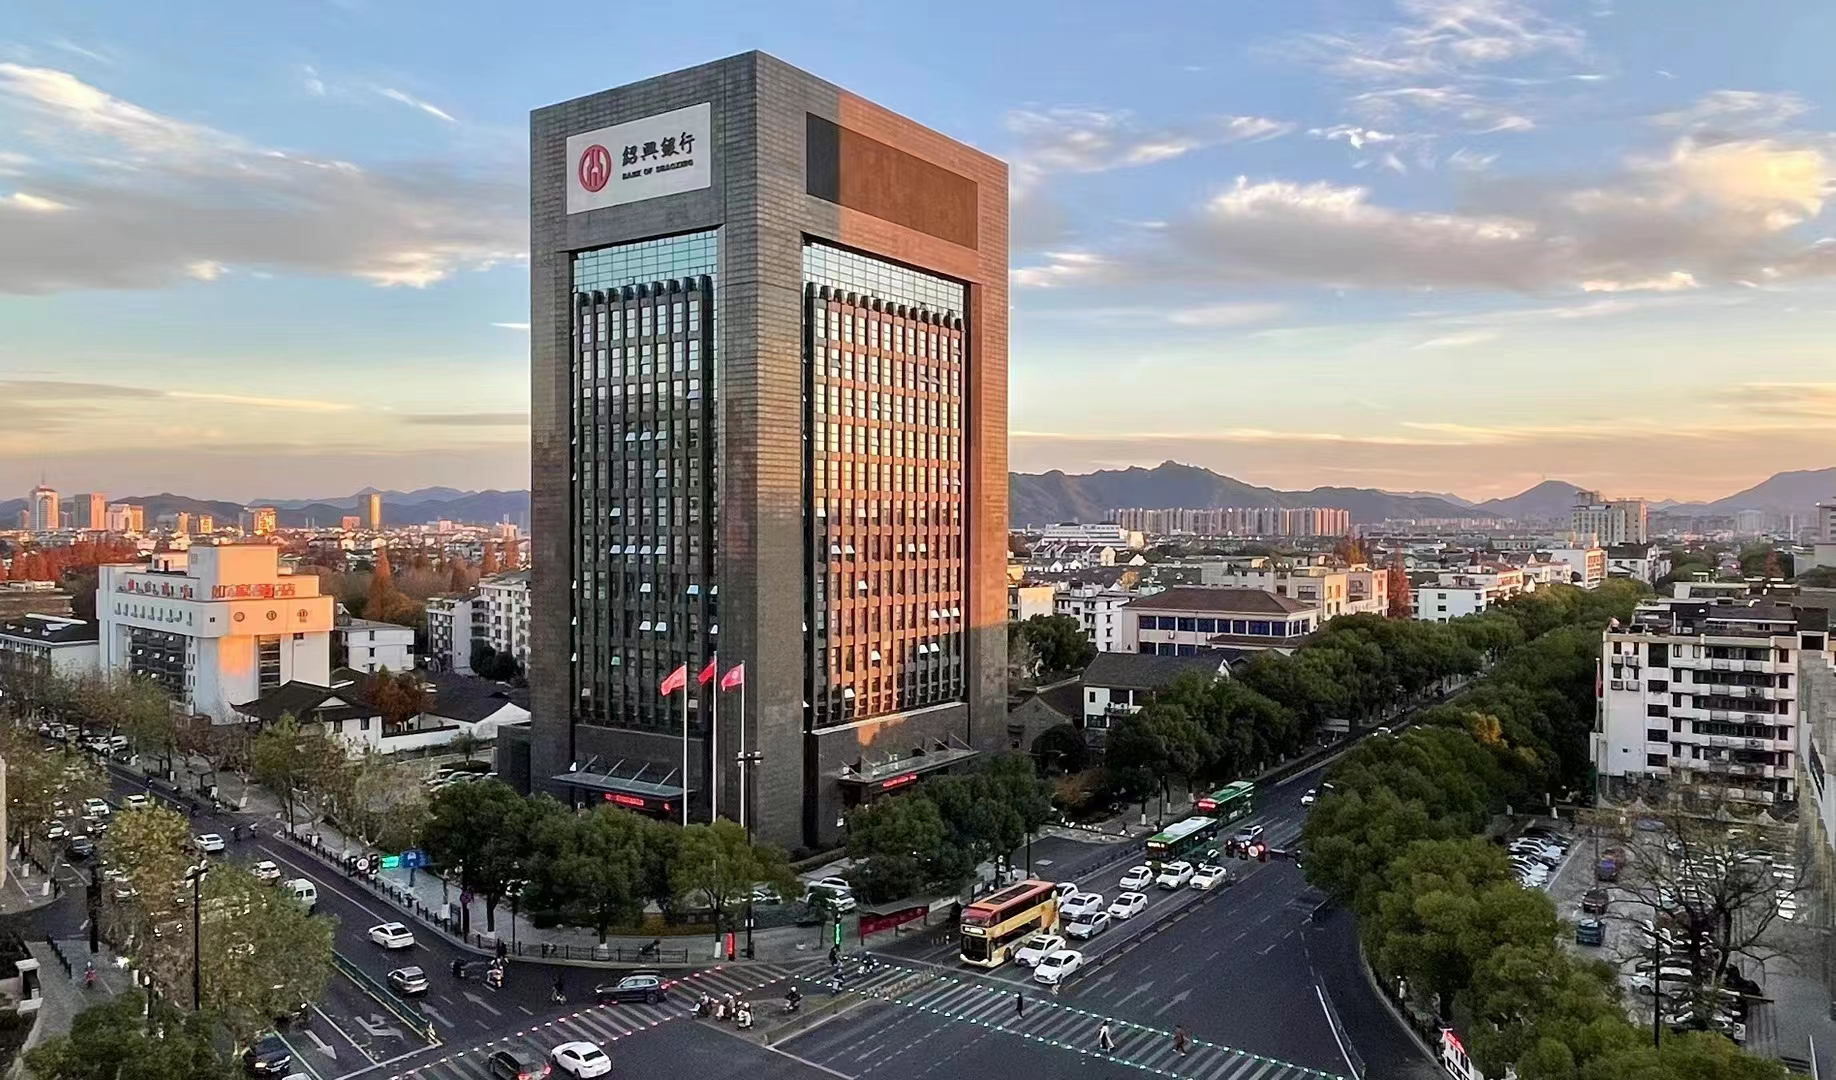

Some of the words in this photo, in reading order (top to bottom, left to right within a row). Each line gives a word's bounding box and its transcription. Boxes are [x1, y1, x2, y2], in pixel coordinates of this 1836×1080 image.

[622, 131, 695, 167] 紹興銀行
[622, 169, 642, 180] BANK
[644, 167, 653, 175] OF
